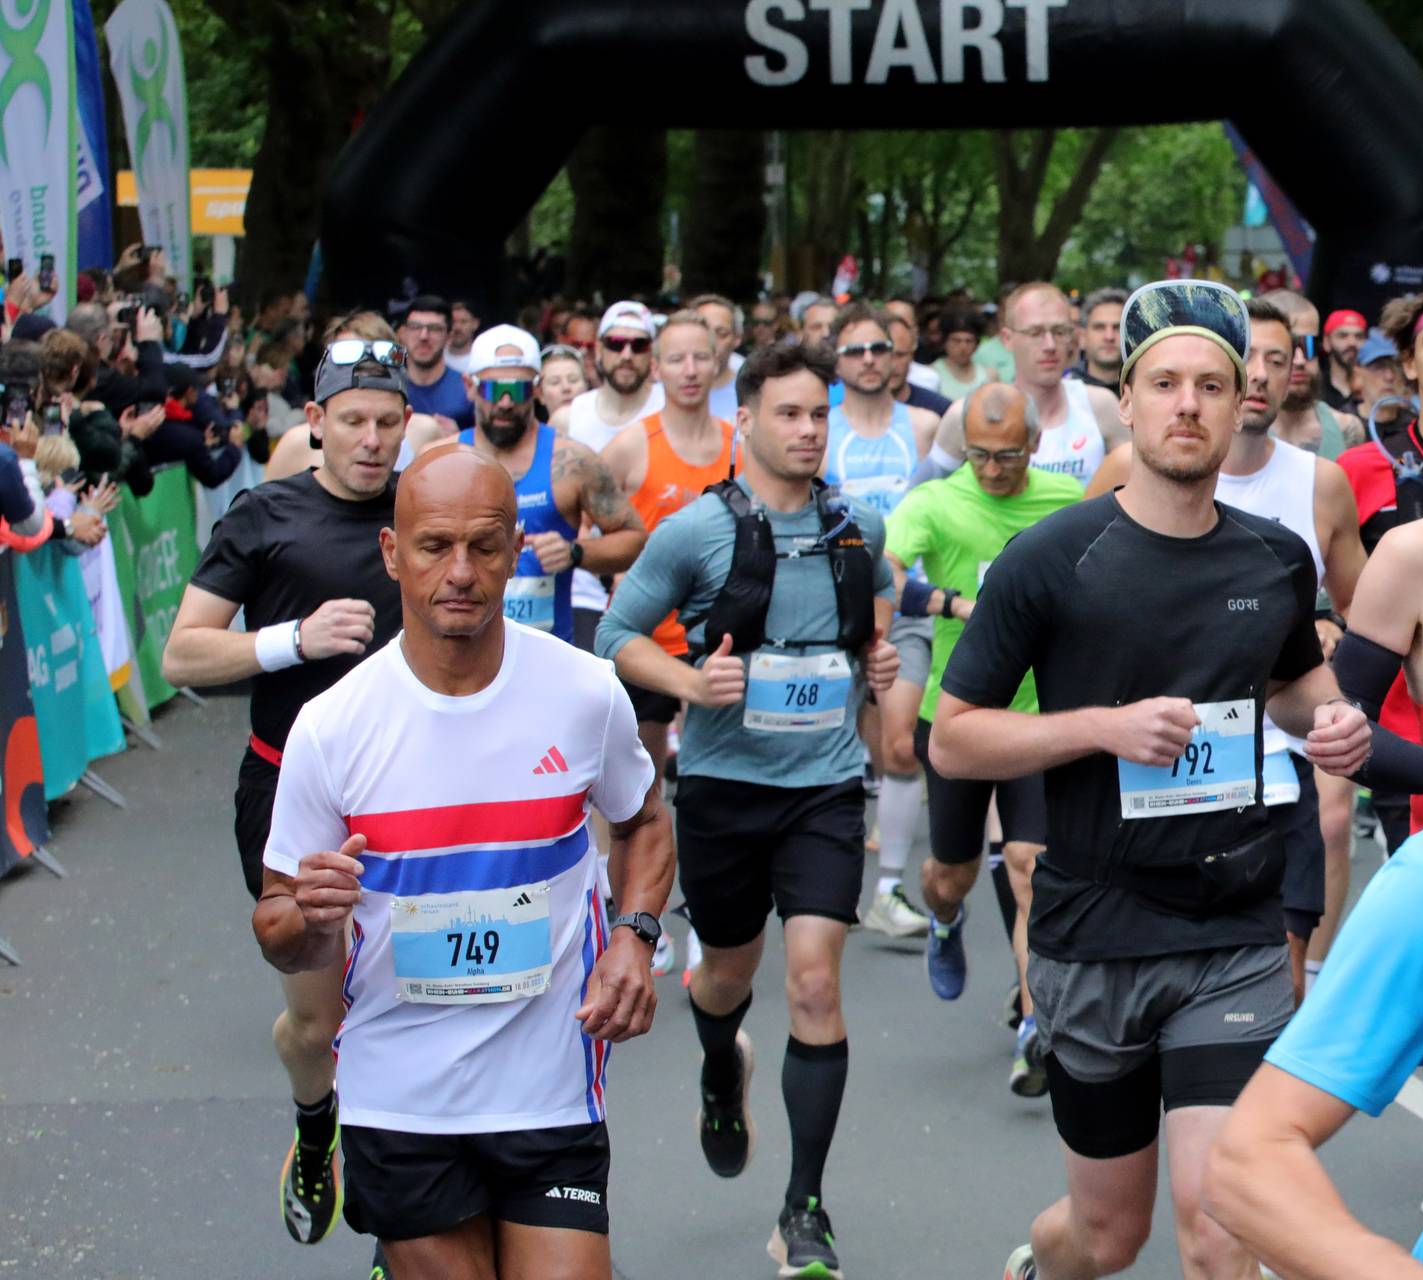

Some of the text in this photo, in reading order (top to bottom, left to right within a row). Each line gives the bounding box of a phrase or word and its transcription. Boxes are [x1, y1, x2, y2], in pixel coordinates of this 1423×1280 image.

[744, 0, 1068, 87] START
[1227, 598, 1260, 611] GORE
[785, 683, 819, 706] 768
[447, 930, 500, 967] 749
[466, 967, 485, 976] Alpha
[563, 1187, 600, 1205] TERREX
